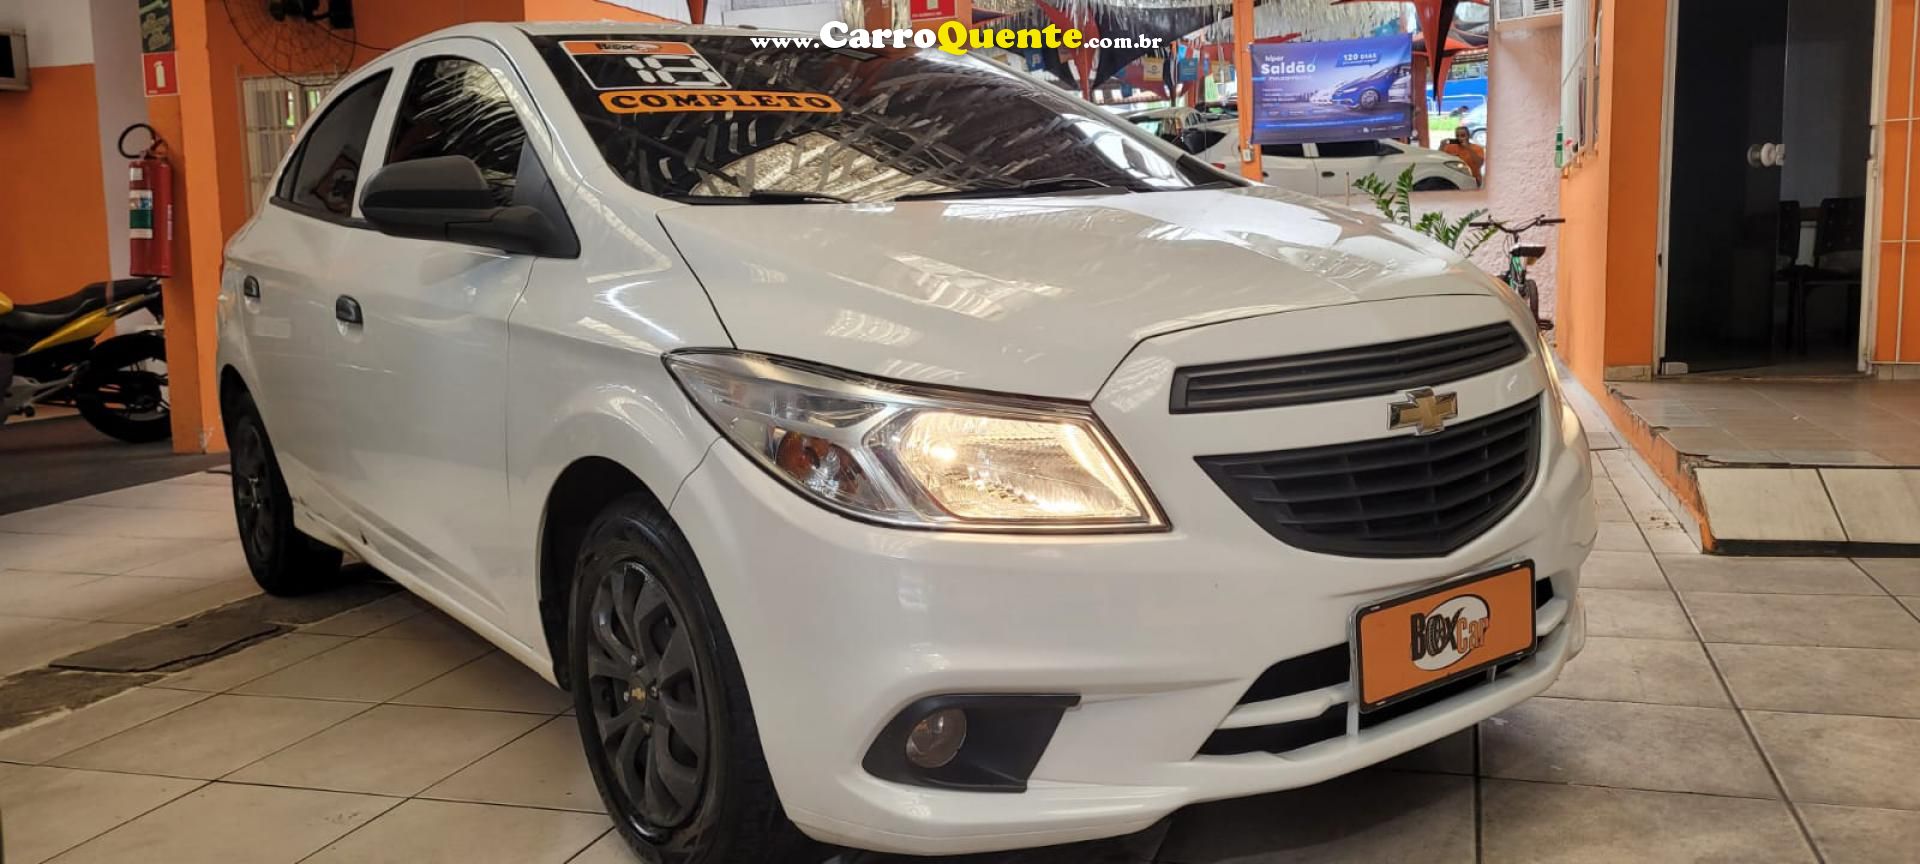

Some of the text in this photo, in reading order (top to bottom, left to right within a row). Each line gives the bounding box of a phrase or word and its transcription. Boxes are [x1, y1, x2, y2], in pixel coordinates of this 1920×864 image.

[1343, 53, 1358, 61] 120
[625, 55, 722, 86] 18
[1260, 61, 1316, 75] Saldão
[610, 93, 832, 110] COMPLETO
